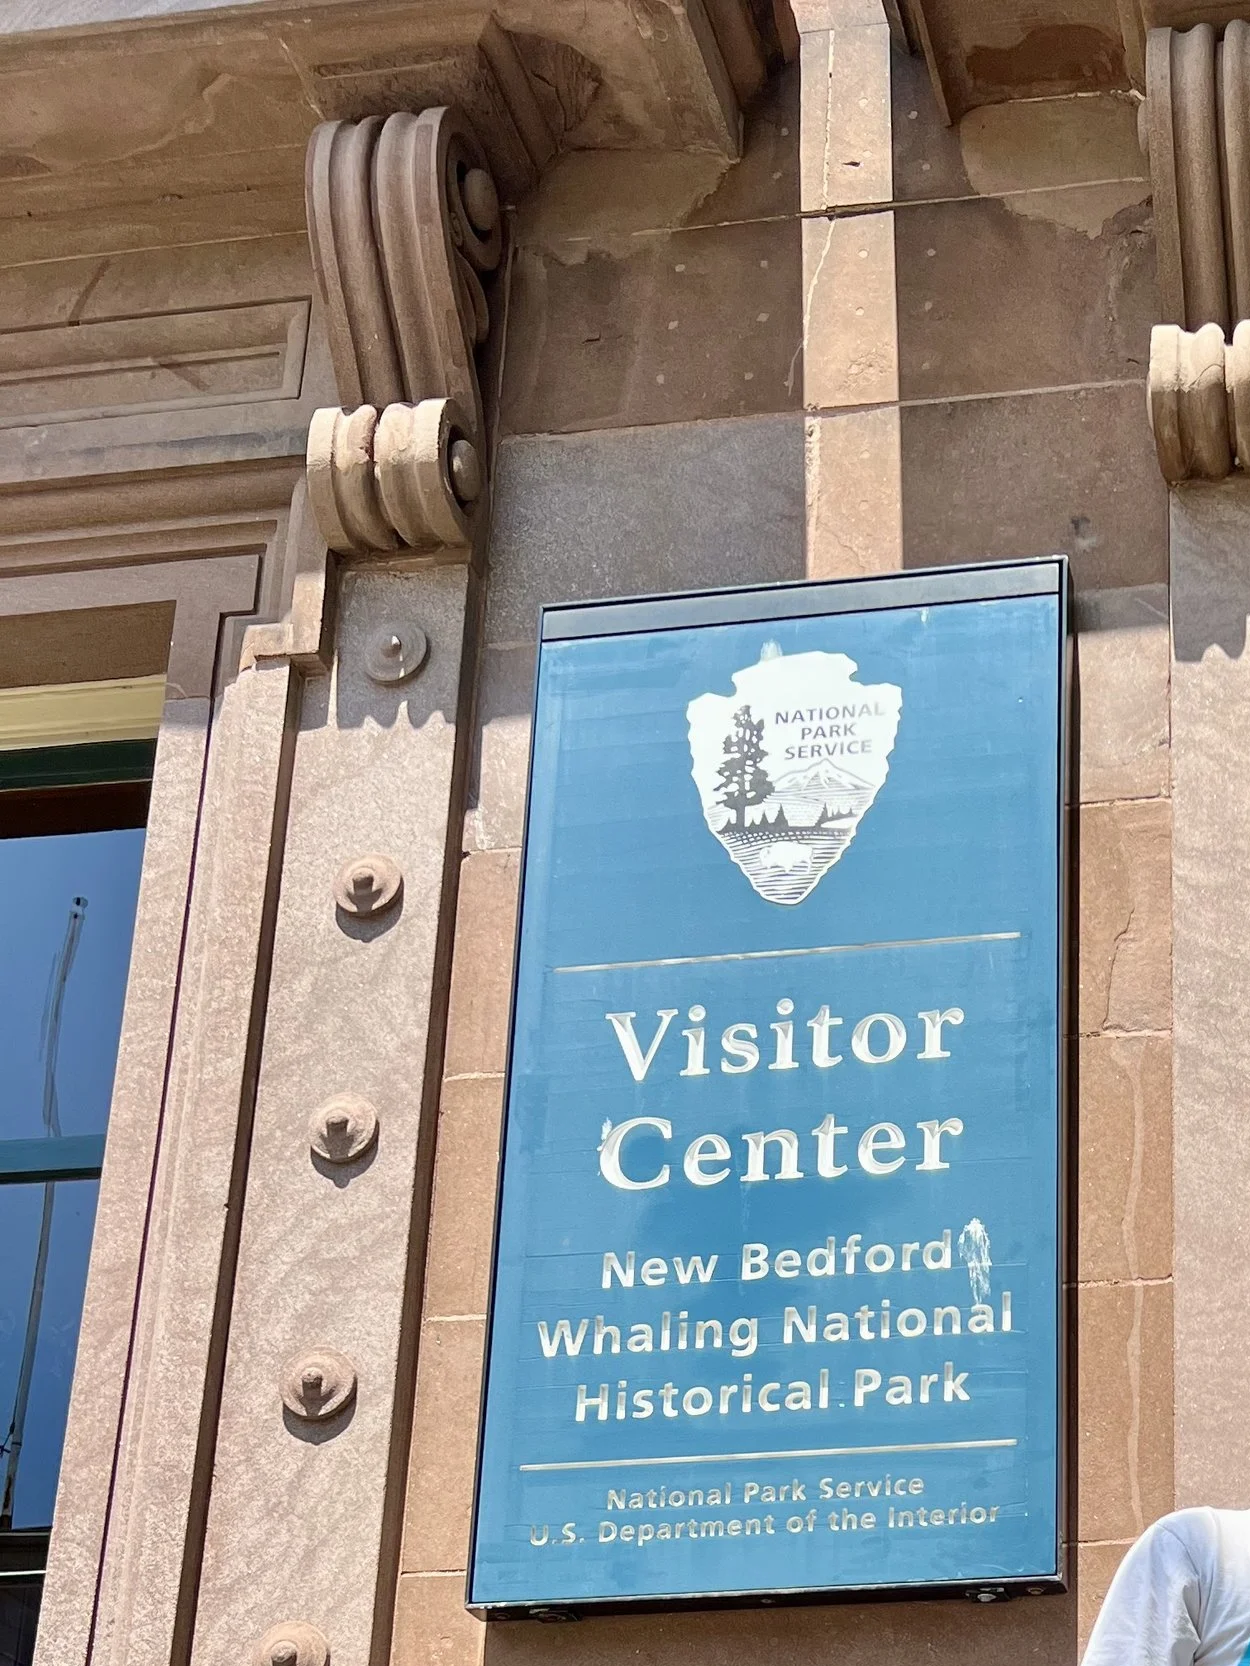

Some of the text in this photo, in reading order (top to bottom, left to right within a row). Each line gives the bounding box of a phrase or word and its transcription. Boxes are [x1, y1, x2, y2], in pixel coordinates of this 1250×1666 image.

[775, 702, 886, 725] NATIONAL
[801, 722, 858, 741] PARK
[783, 739, 874, 761] SERVICE
[605, 998, 965, 1082] Visitor
[599, 1113, 965, 1191] Center
[601, 1229, 952, 1289] New Bedford
[537, 1292, 1013, 1359] Whaling National
[574, 1361, 972, 1422] Historical Park
[607, 1473, 924, 1511] National Park Service
[529, 1502, 1000, 1546] U.S. Department of the Interior
